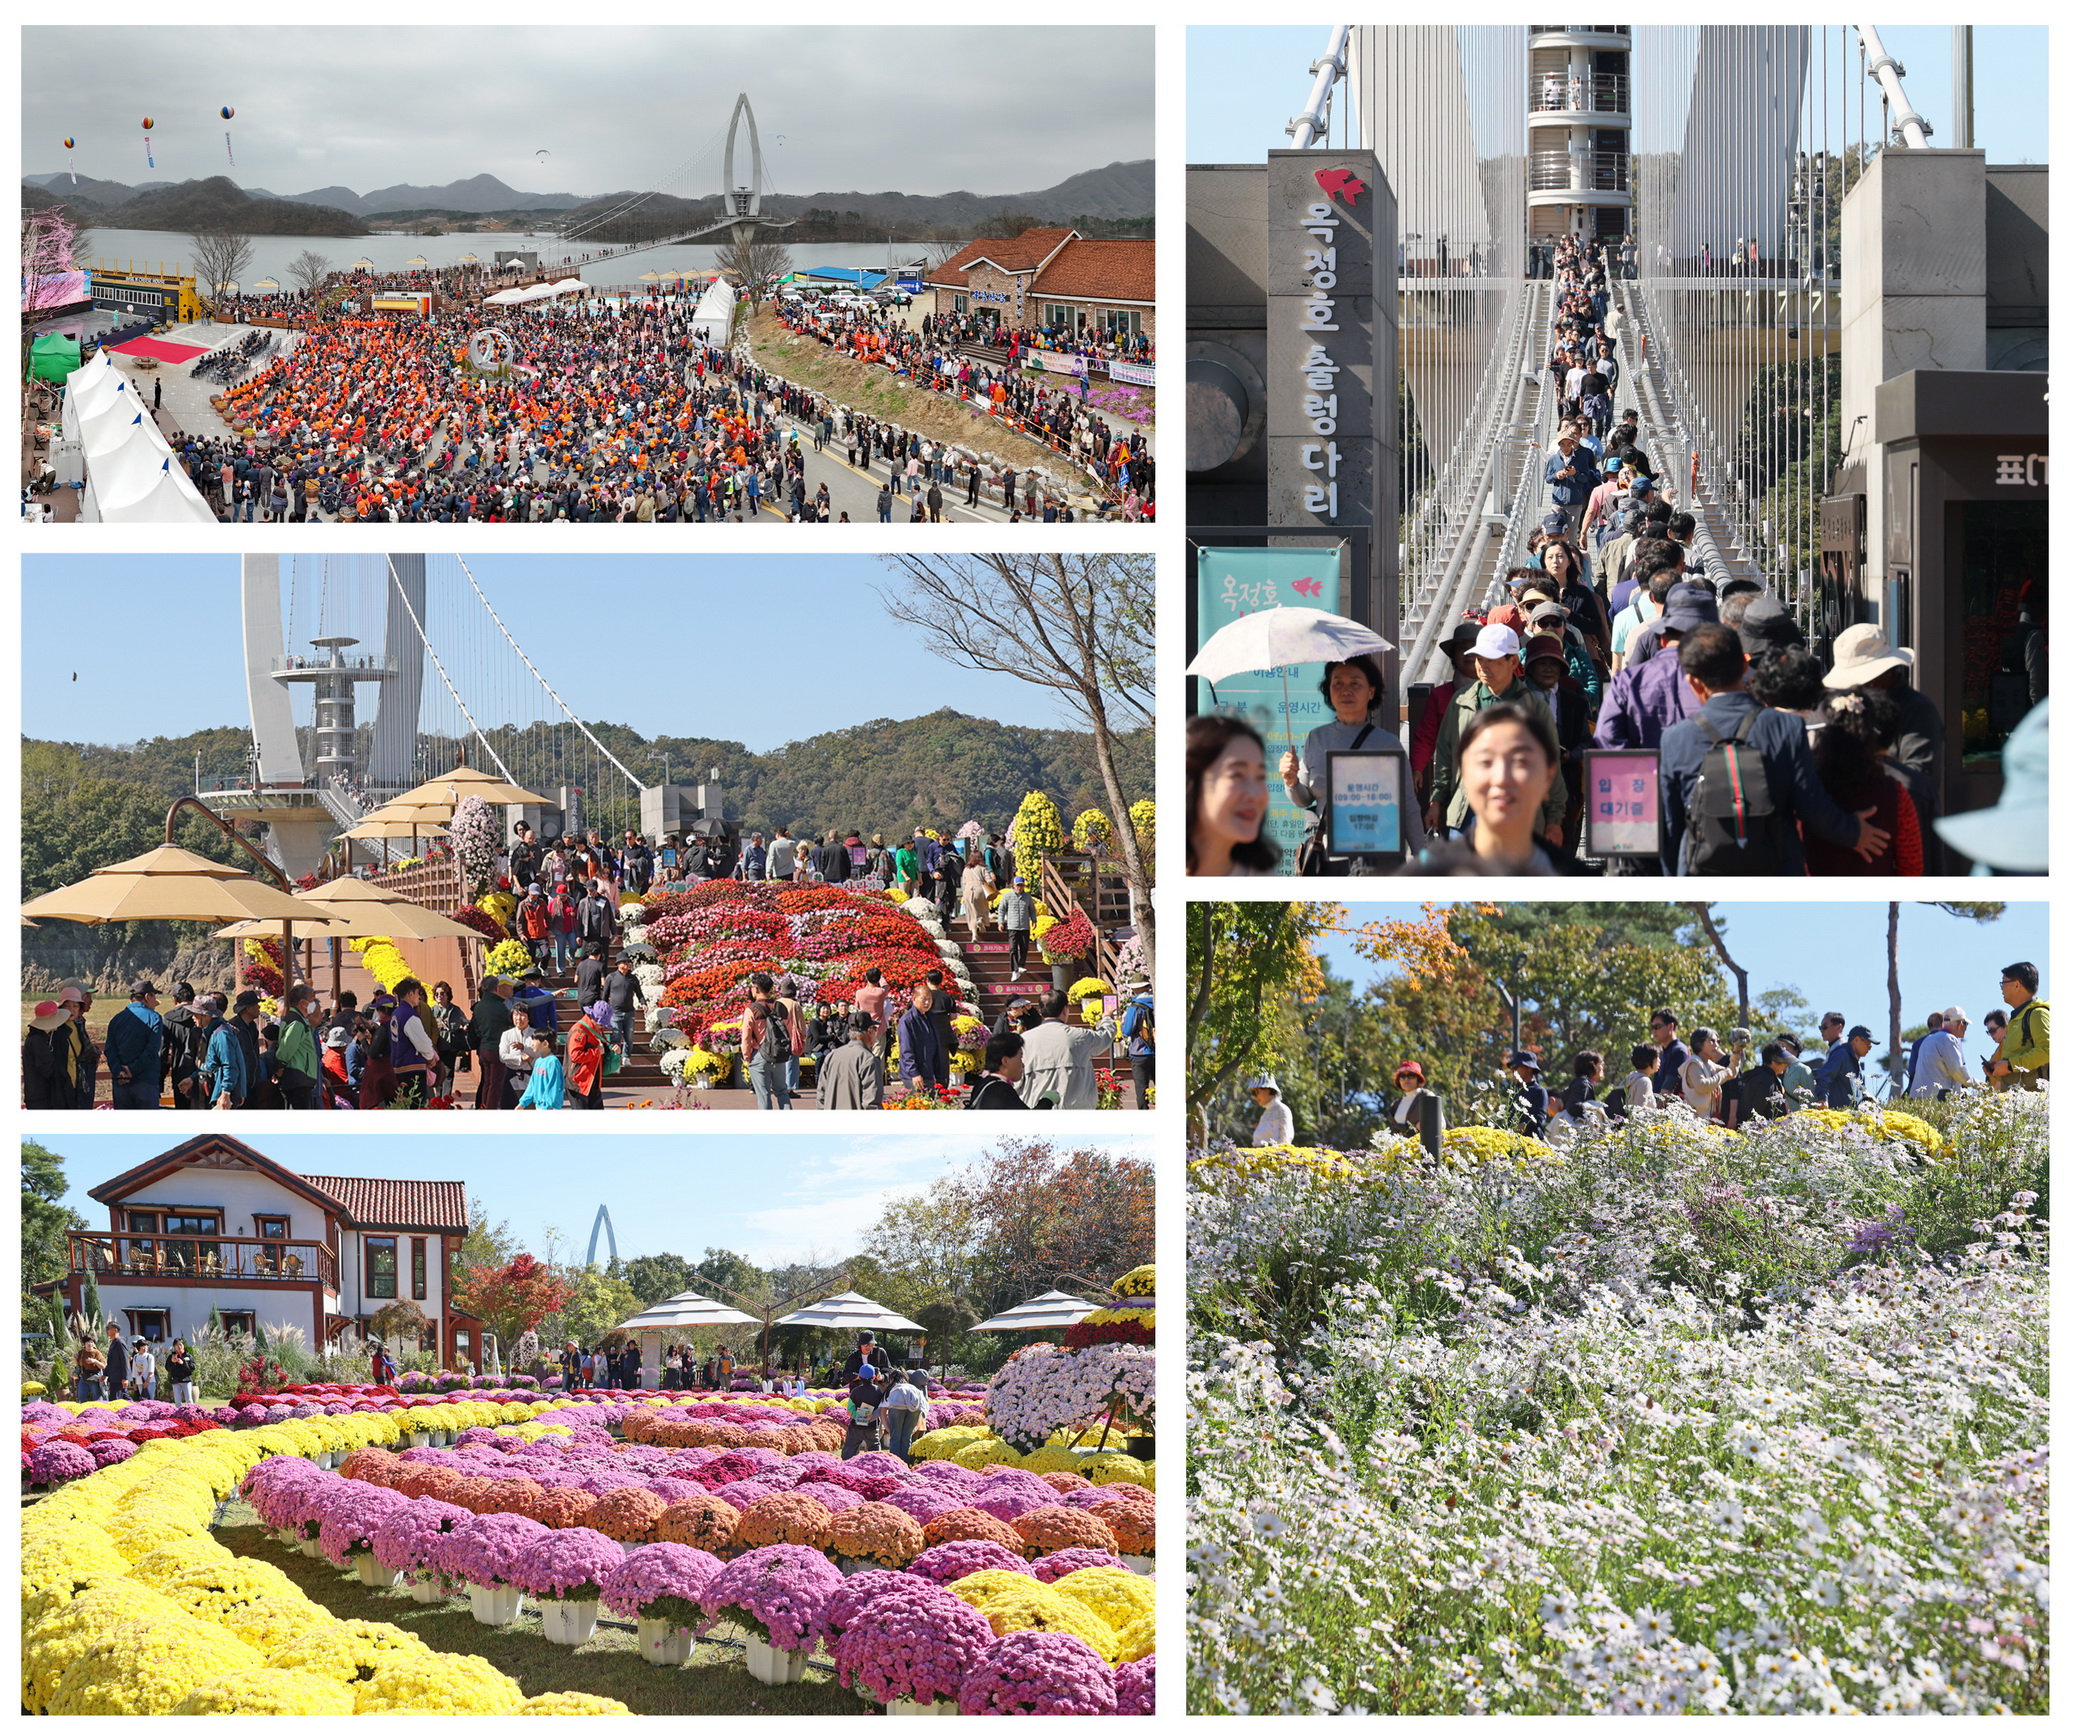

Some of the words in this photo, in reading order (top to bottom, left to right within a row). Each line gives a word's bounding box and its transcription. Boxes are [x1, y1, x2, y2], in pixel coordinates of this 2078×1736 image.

[1300, 203, 1340, 331] 옥정호
[1300, 345, 1342, 518] 출렁다리
[1220, 574, 1279, 612] 옥정호
[1277, 702, 1321, 714] 운영시간
[1600, 801, 1644, 816] 대기줄
